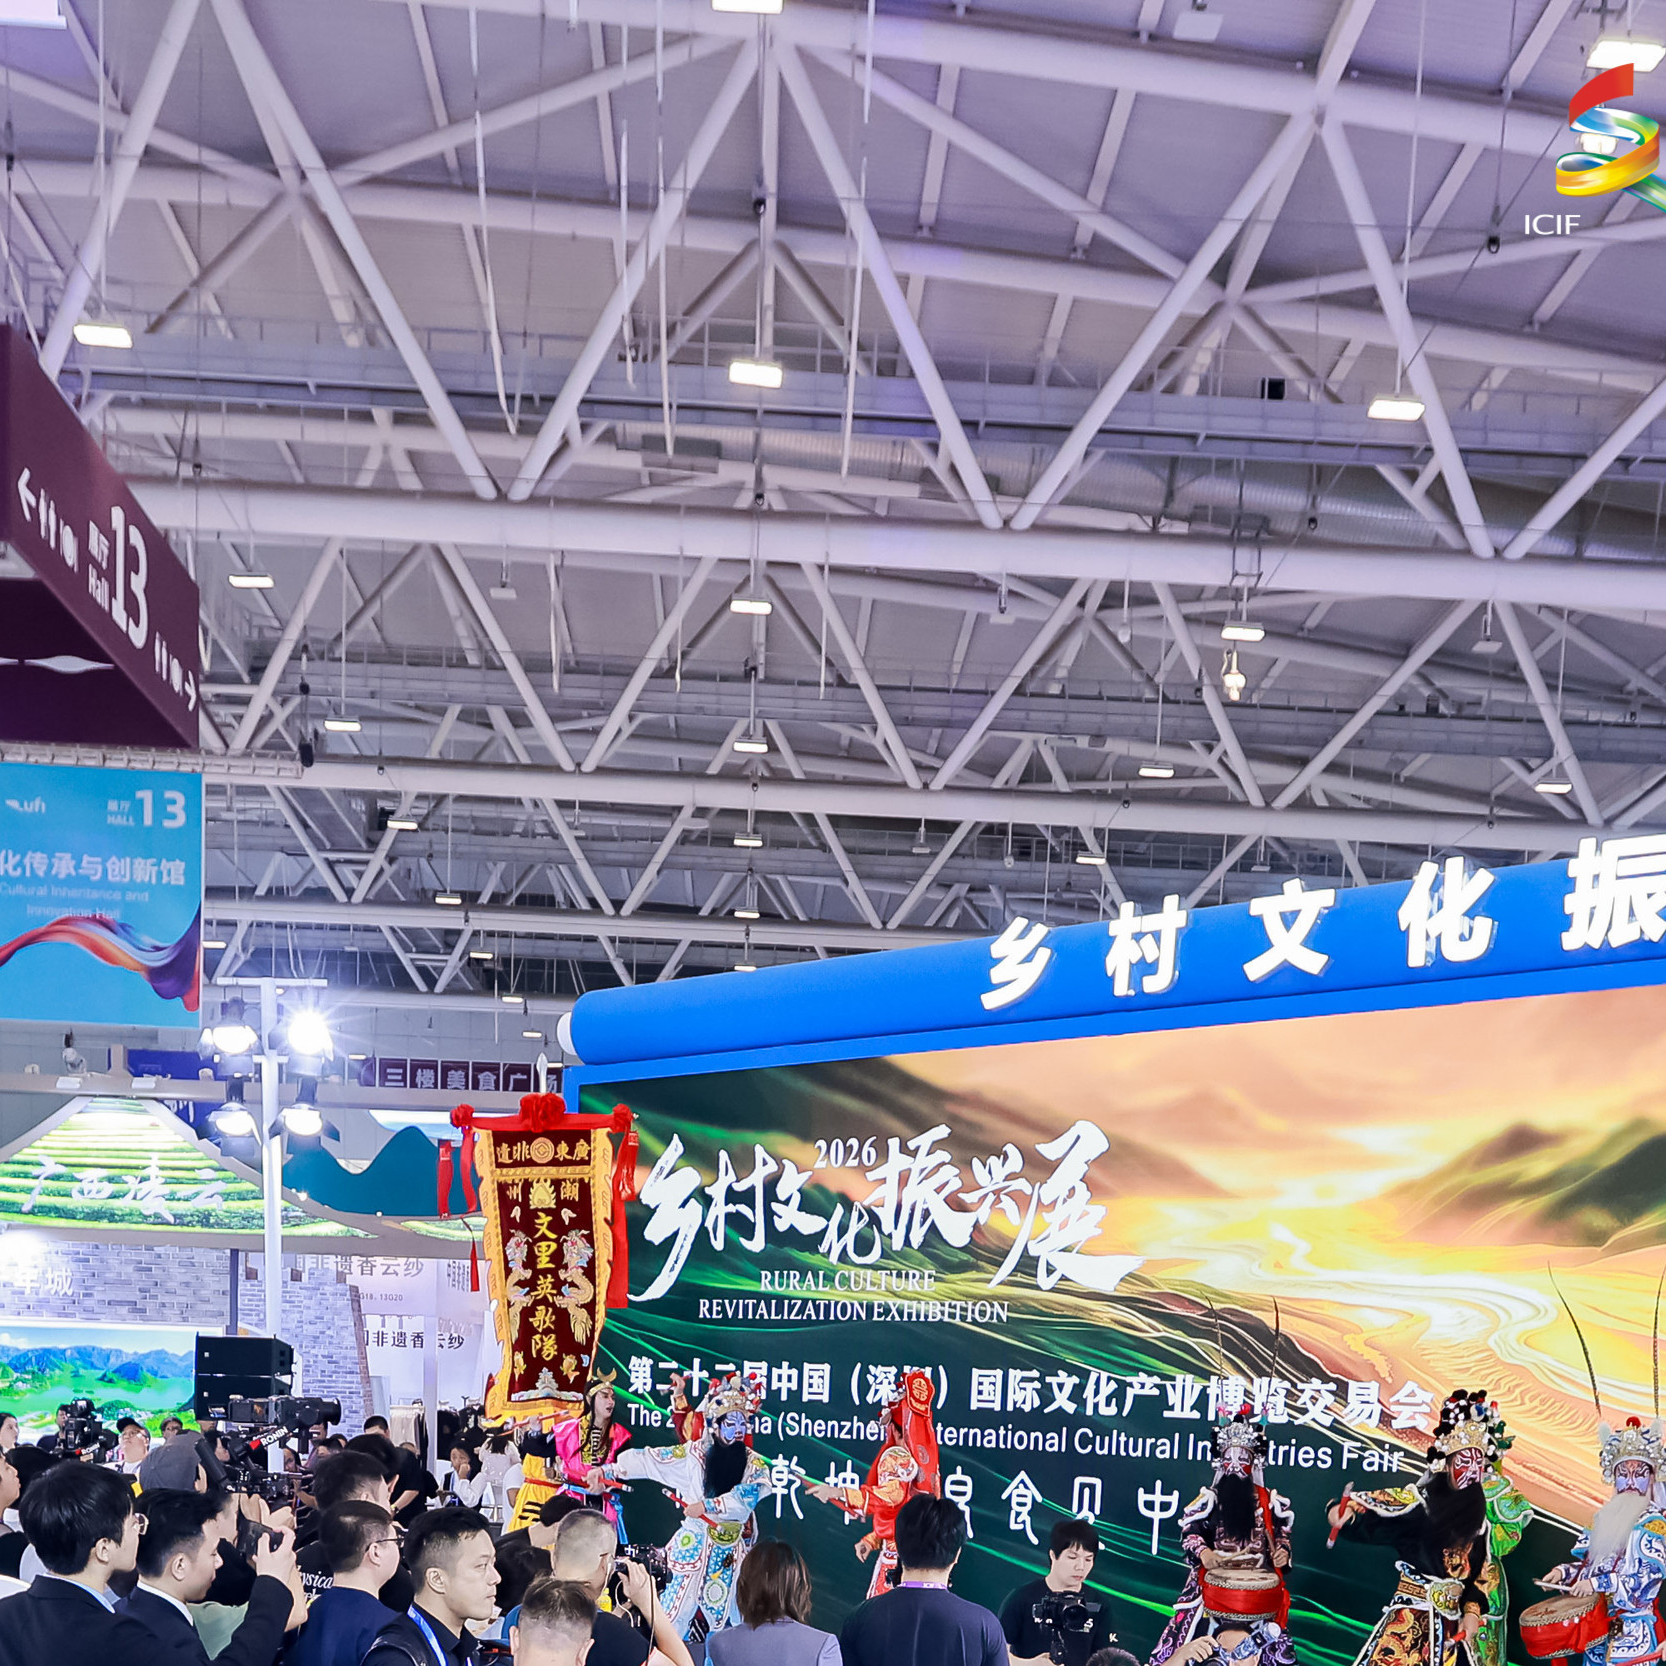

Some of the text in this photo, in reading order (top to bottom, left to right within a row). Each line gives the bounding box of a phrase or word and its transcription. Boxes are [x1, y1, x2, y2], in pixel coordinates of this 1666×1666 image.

[88, 562, 110, 614] Hall
[110, 505, 149, 650] 13
[134, 789, 187, 829] 13
[50, 884, 122, 900] Inheritance
[124, 889, 149, 902] and
[813, 1136, 877, 1169] 2026
[627, 1119, 1145, 1301] 乡村文化振兴展
[528, 1211, 559, 1361] 文里英歌隊
[759, 1269, 936, 1293] RURAL CULTURE
[698, 1298, 1009, 1324] REVITALIZATION EXHIBITION
[260, 1425, 289, 1448] RONIN
[626, 1402, 663, 1427] The
[935, 1421, 1067, 1454] ternational
[1074, 1427, 1180, 1461] Cultural
[1187, 1432, 1333, 1469] Intries
[1341, 1439, 1405, 1474] Fair
